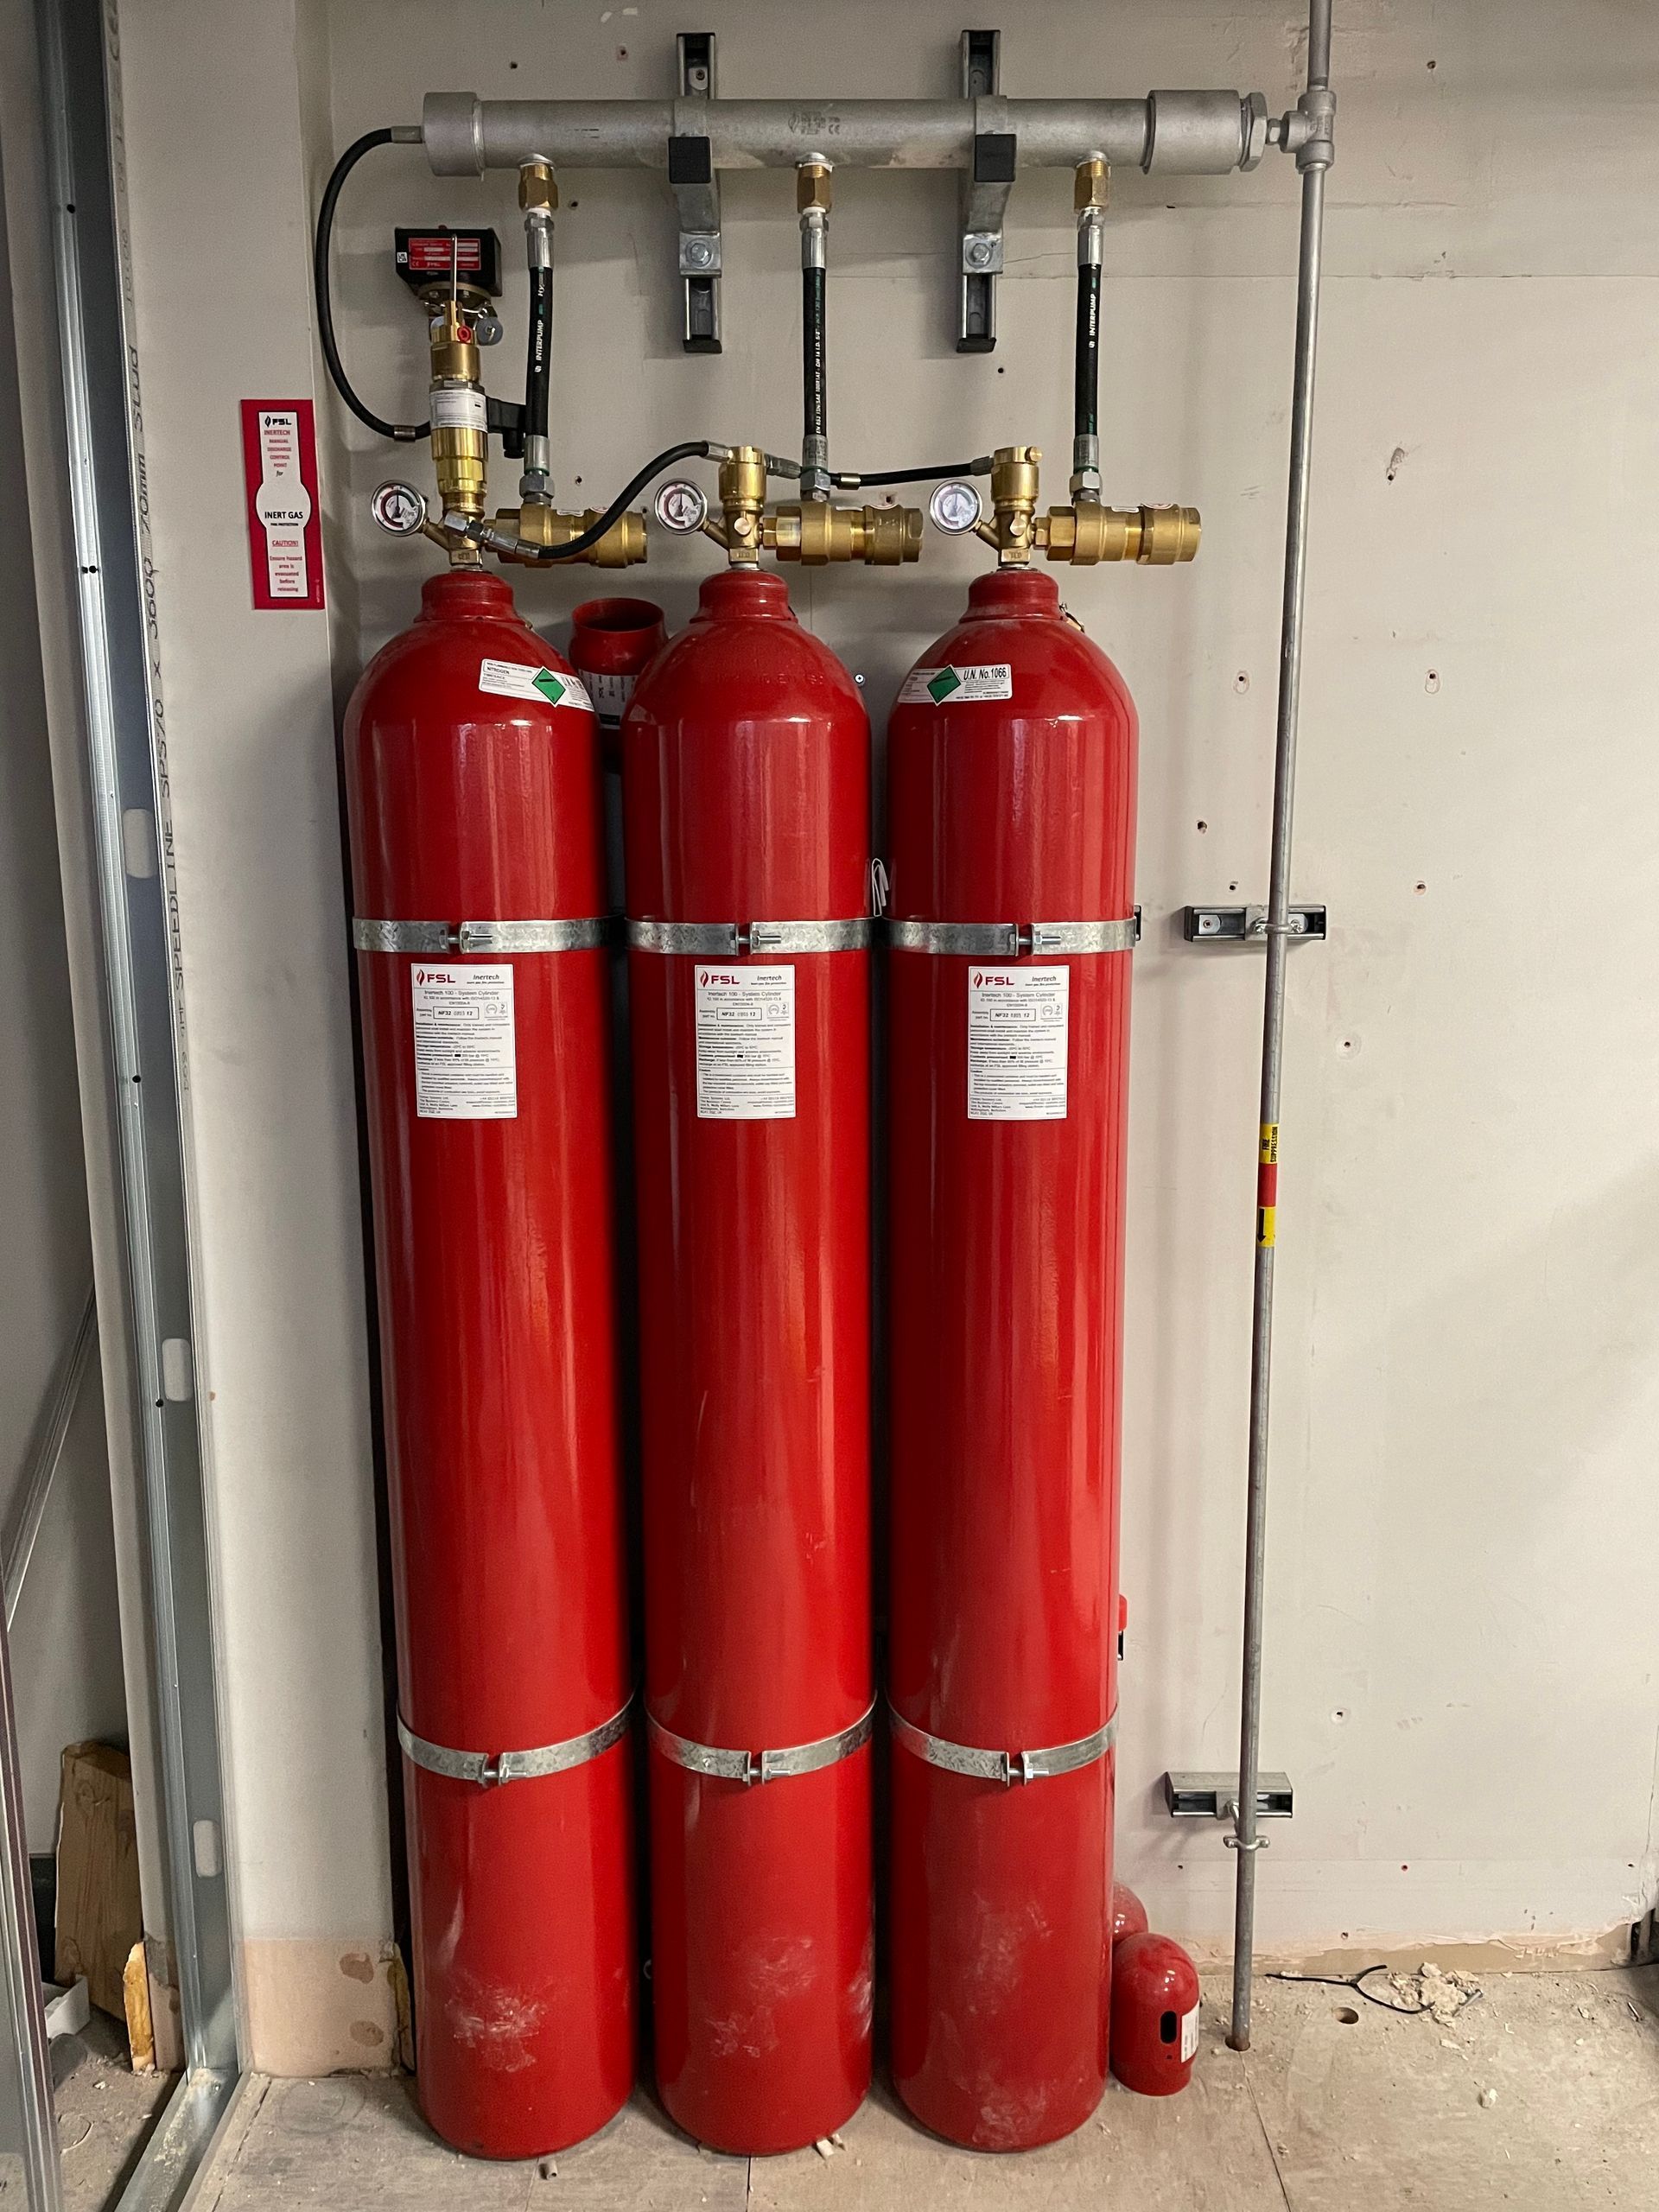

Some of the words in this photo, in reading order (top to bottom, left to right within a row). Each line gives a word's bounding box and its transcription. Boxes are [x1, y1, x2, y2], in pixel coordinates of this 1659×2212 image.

[130, 345, 143, 415] Stud
[487, 666, 510, 675] NITROGEN
[963, 669, 977, 680] U.N.
[163, 821, 184, 991] SPEEDLINE
[427, 974, 456, 983] FSL
[711, 976, 741, 984] FSL
[985, 976, 1015, 985] FSL
